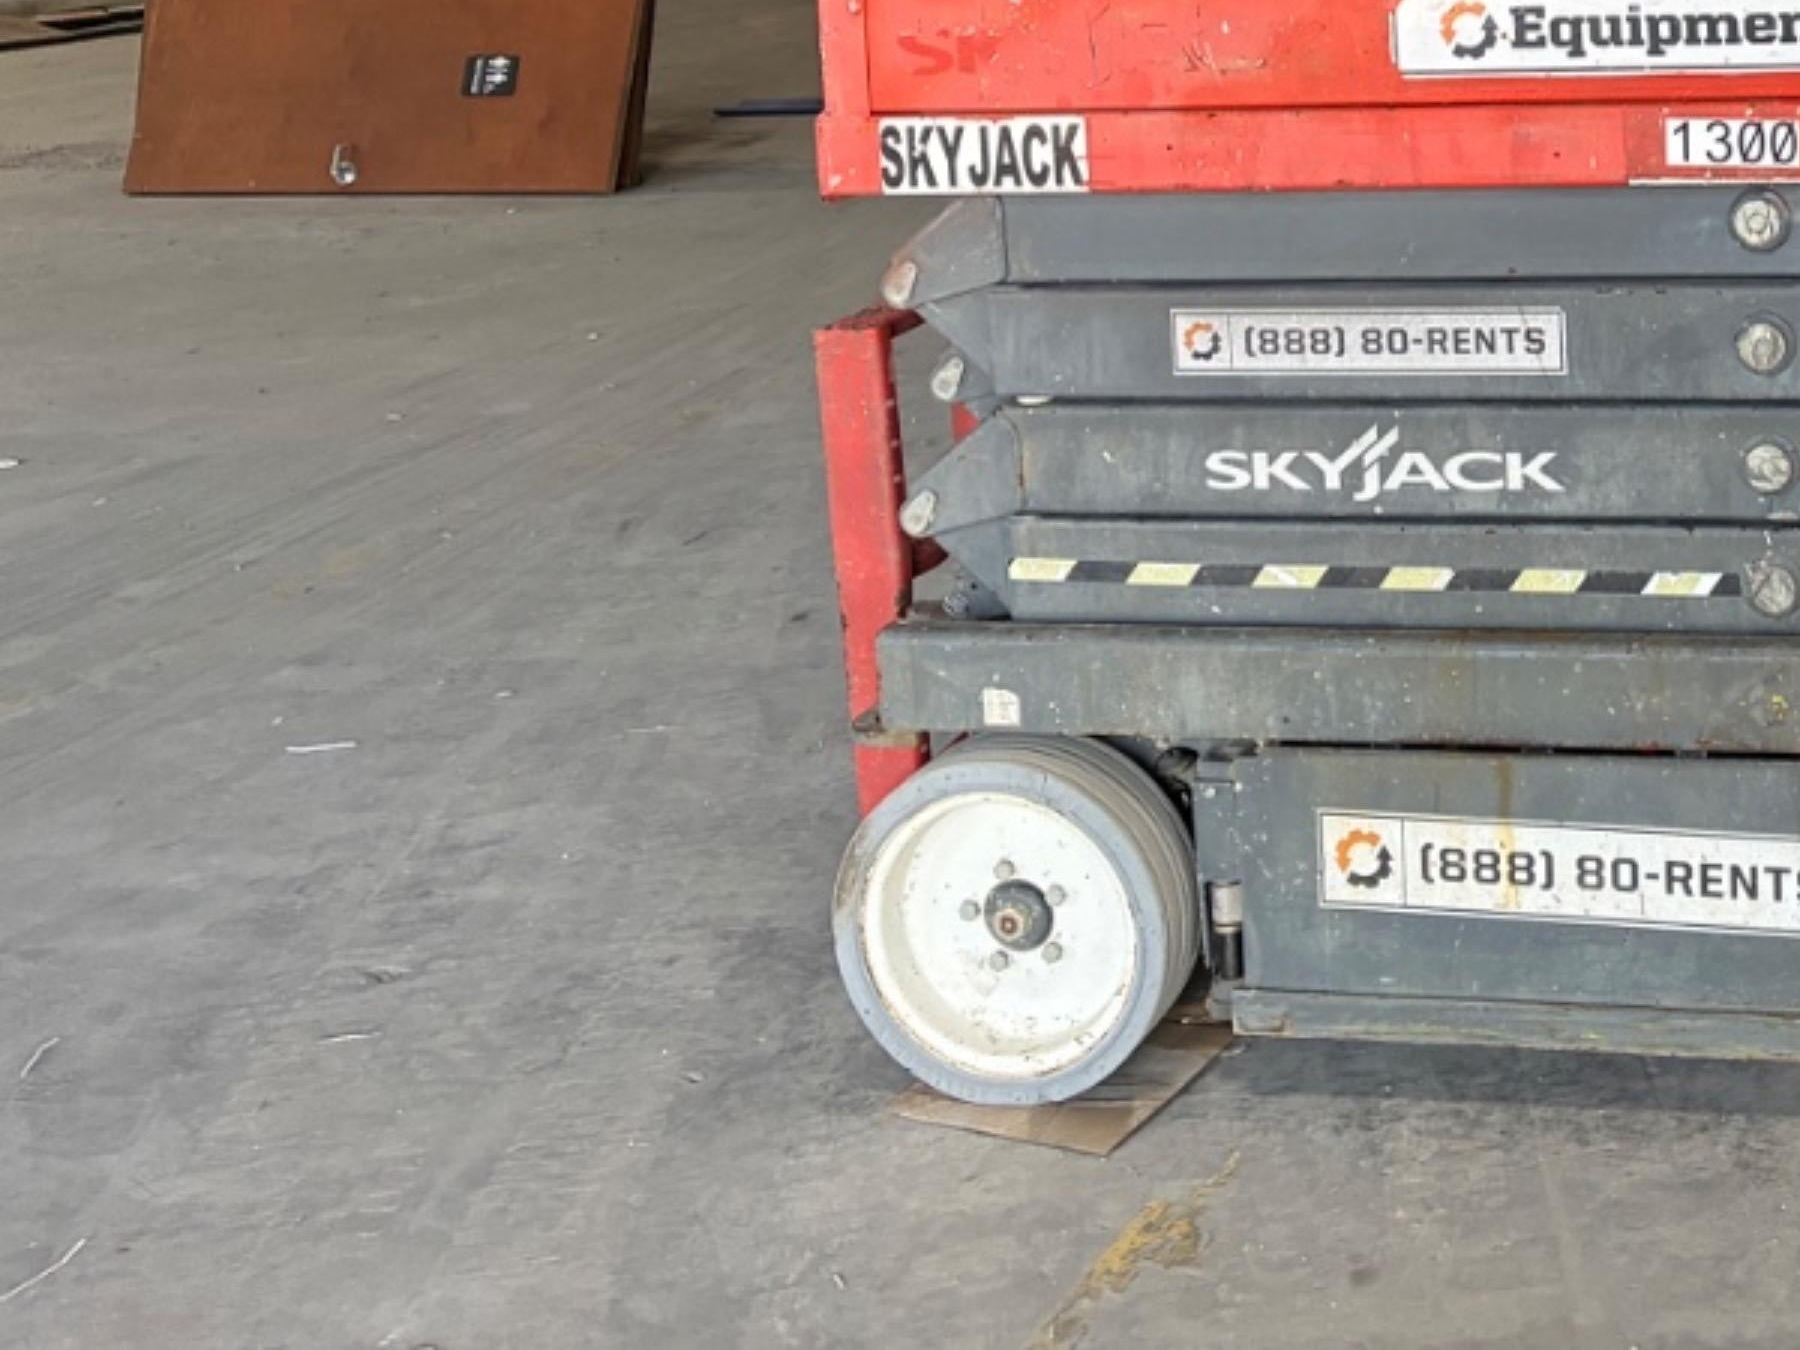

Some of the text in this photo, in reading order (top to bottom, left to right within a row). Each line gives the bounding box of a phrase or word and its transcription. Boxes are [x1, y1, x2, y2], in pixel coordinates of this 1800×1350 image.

[880, 123, 1084, 189] SKYJACK
[1672, 120, 1798, 165] 1300
[1243, 326, 1548, 358] (888) 80-RENTS
[1205, 425, 1566, 503] SKYJACK
[1419, 842, 1556, 892] (888)
